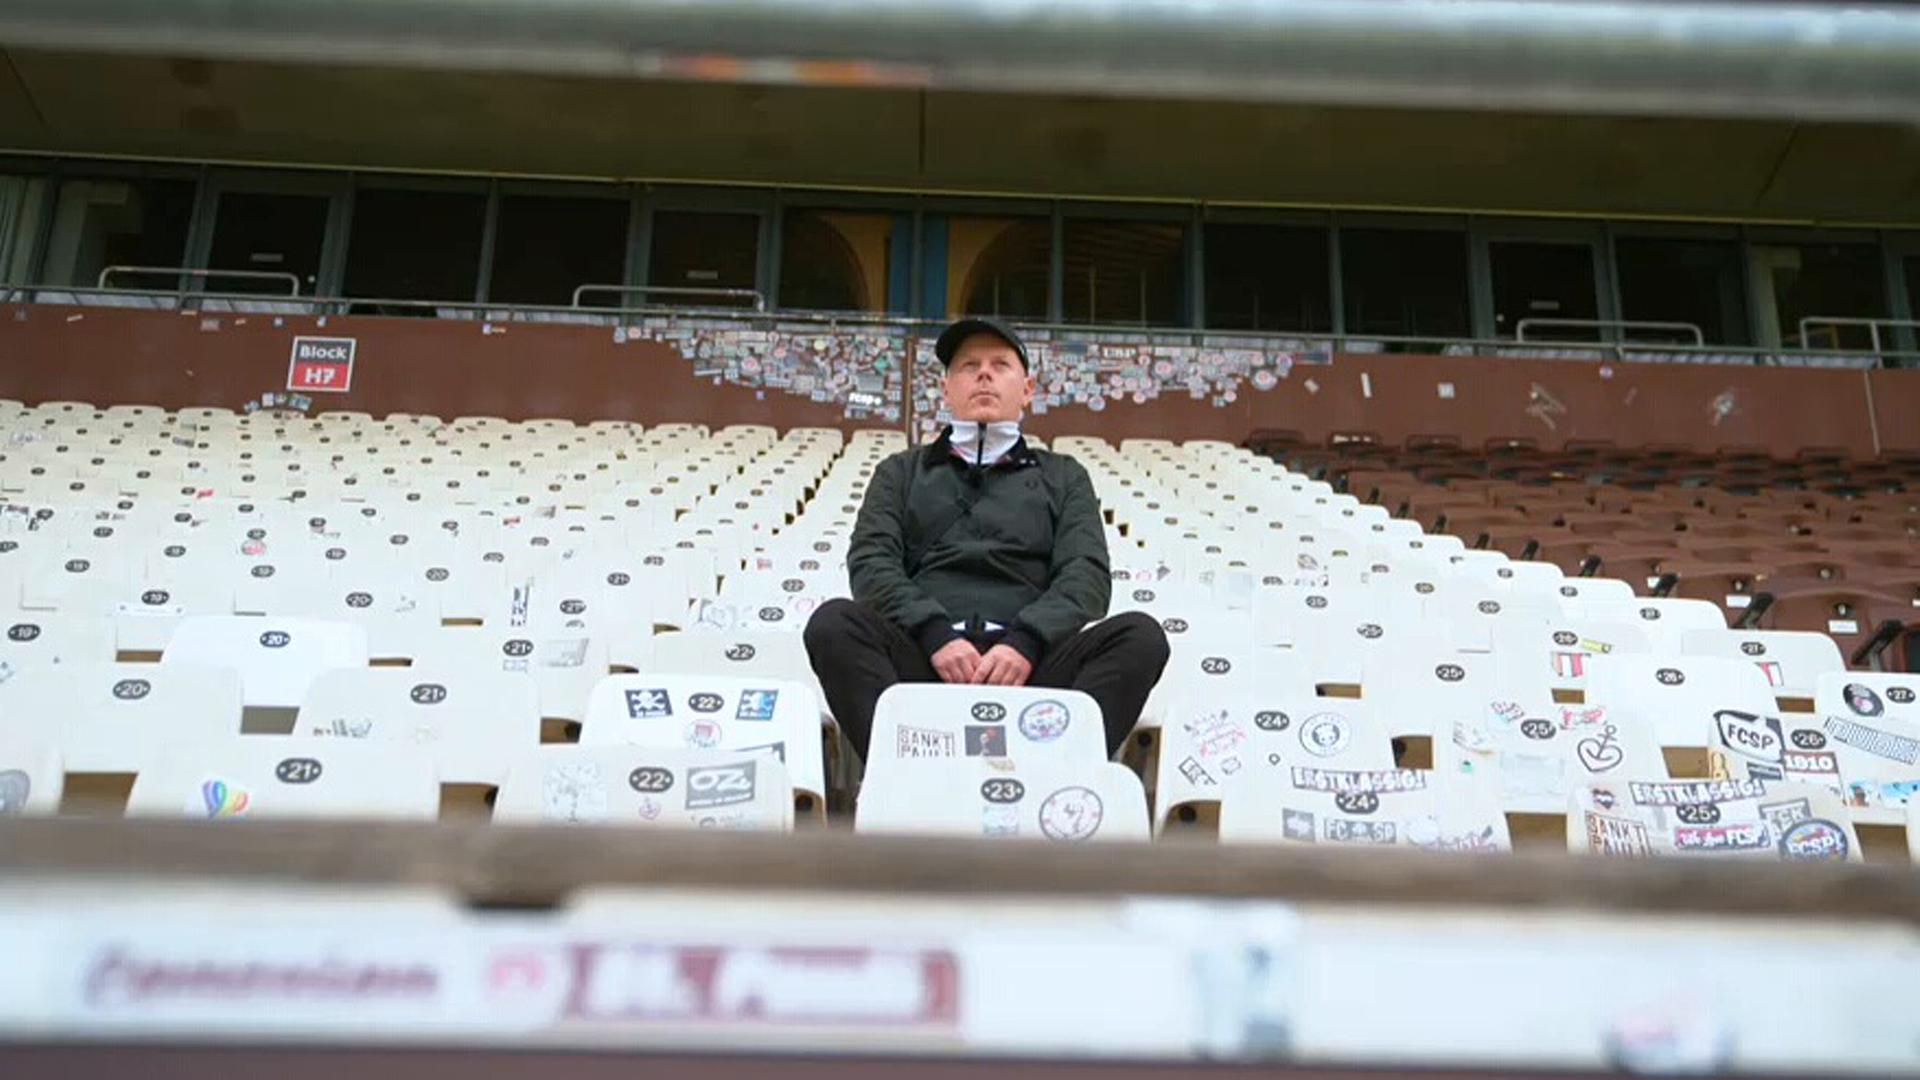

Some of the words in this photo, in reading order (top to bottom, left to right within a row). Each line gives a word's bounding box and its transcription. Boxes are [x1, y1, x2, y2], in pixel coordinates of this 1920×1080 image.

[300, 345, 347, 360] Block
[304, 367, 336, 385] H7
[268, 634, 284, 646] 20
[512, 641, 527, 654] 21
[1207, 658, 1225, 672] 24
[1443, 666, 1459, 680] 25
[121, 682, 144, 697] 20
[420, 687, 438, 702] 21
[1893, 689, 1908, 702] 27
[697, 695, 716, 709] 22
[978, 704, 999, 720] 23
[1261, 712, 1282, 728] 24
[1529, 720, 1549, 738] 25
[1726, 724, 1774, 750] FCSP
[900, 729, 951, 749] SANKT
[1798, 732, 1819, 748] 26
[287, 761, 312, 782] 21
[637, 771, 664, 789] 22
[1294, 769, 1425, 793] ERSTKLASSIG!
[989, 782, 1015, 799] 23
[1632, 780, 1764, 805] ERSTKLASSIG!
[1344, 793, 1369, 810] 24
[1687, 804, 1712, 821] 25
